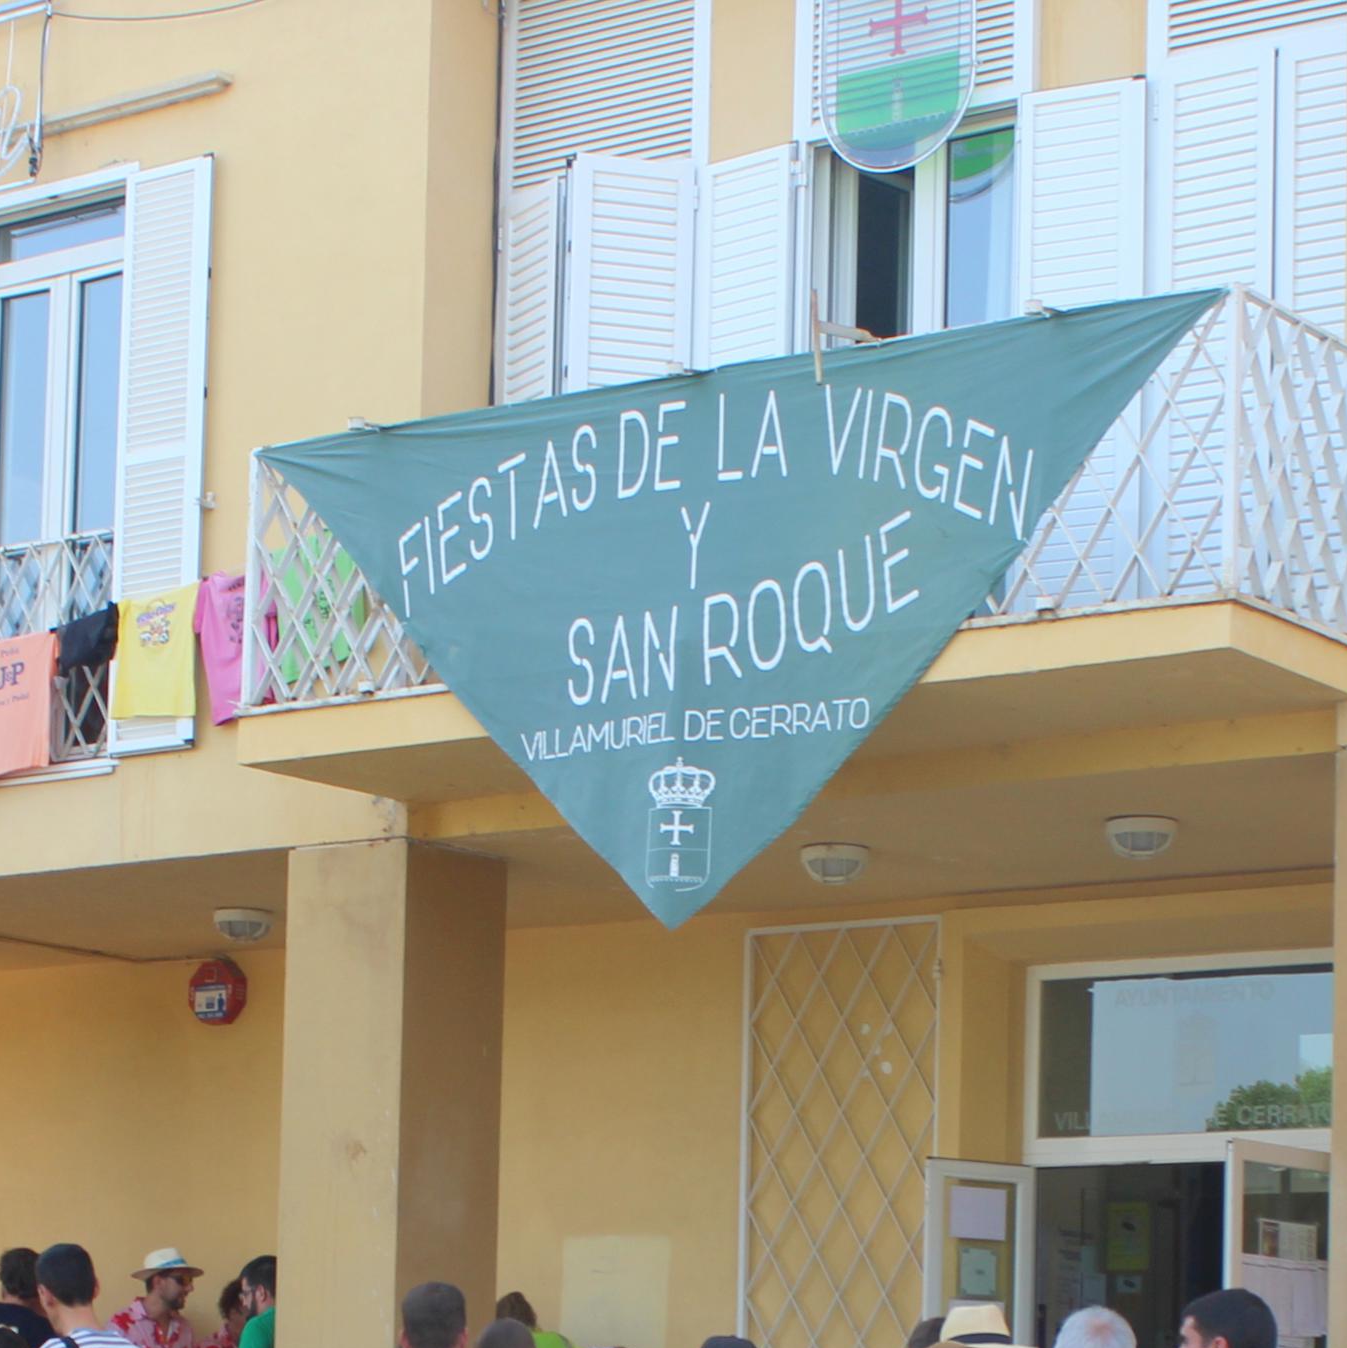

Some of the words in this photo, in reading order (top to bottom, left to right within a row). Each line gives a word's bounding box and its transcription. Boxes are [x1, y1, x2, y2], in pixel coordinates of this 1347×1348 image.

[398, 423, 598, 618] FIESTAS
[618, 399, 687, 499] DE
[717, 389, 788, 481] LA
[824, 383, 1034, 542] VIRGEN
[681, 501, 711, 590] Y
[567, 604, 679, 706] SAN
[703, 509, 920, 686] ROQUE
[520, 711, 676, 761] VILLAMURIEL
[684, 709, 725, 741] DE
[729, 697, 870, 740] CERRATO
[1115, 982, 1274, 1008] AYUNTAMIENTO
